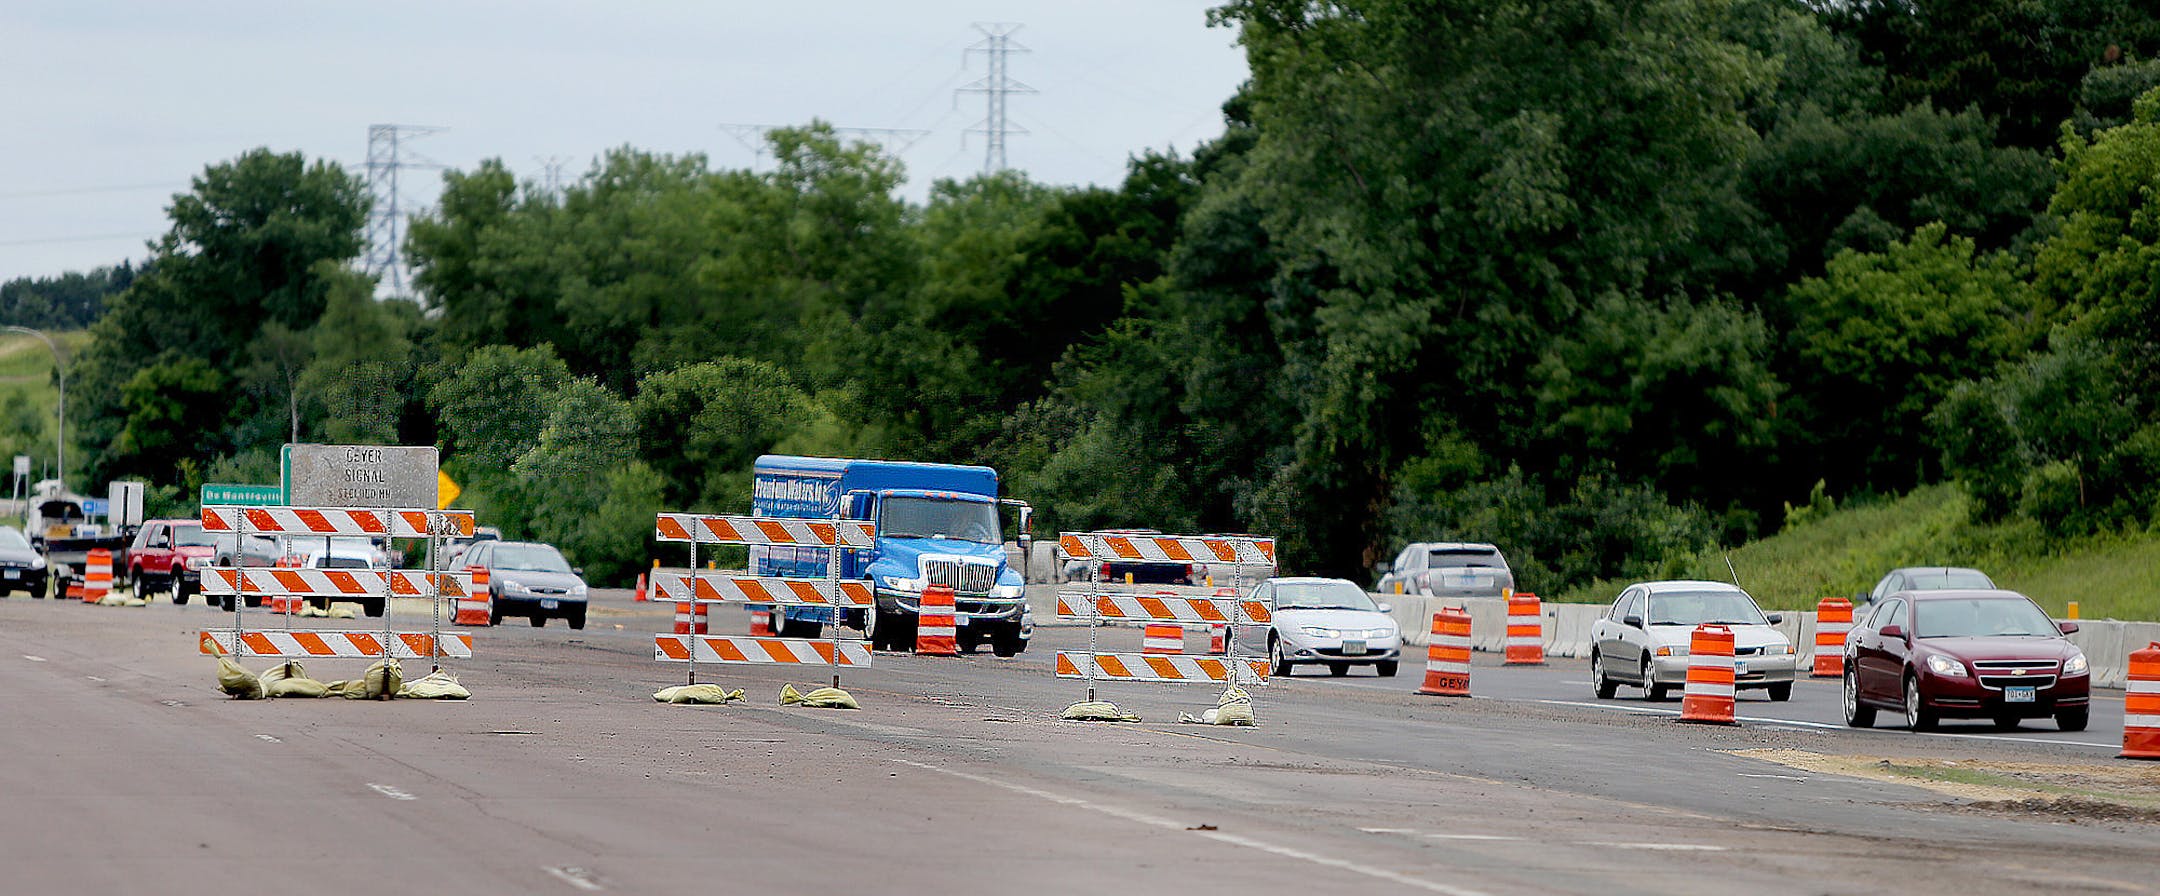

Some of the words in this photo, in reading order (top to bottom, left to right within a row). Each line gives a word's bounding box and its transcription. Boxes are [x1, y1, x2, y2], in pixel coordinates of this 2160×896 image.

[346, 449, 382, 463] GEYER
[344, 469, 385, 483] SIGNAL
[223, 491, 279, 501] Montrevill
